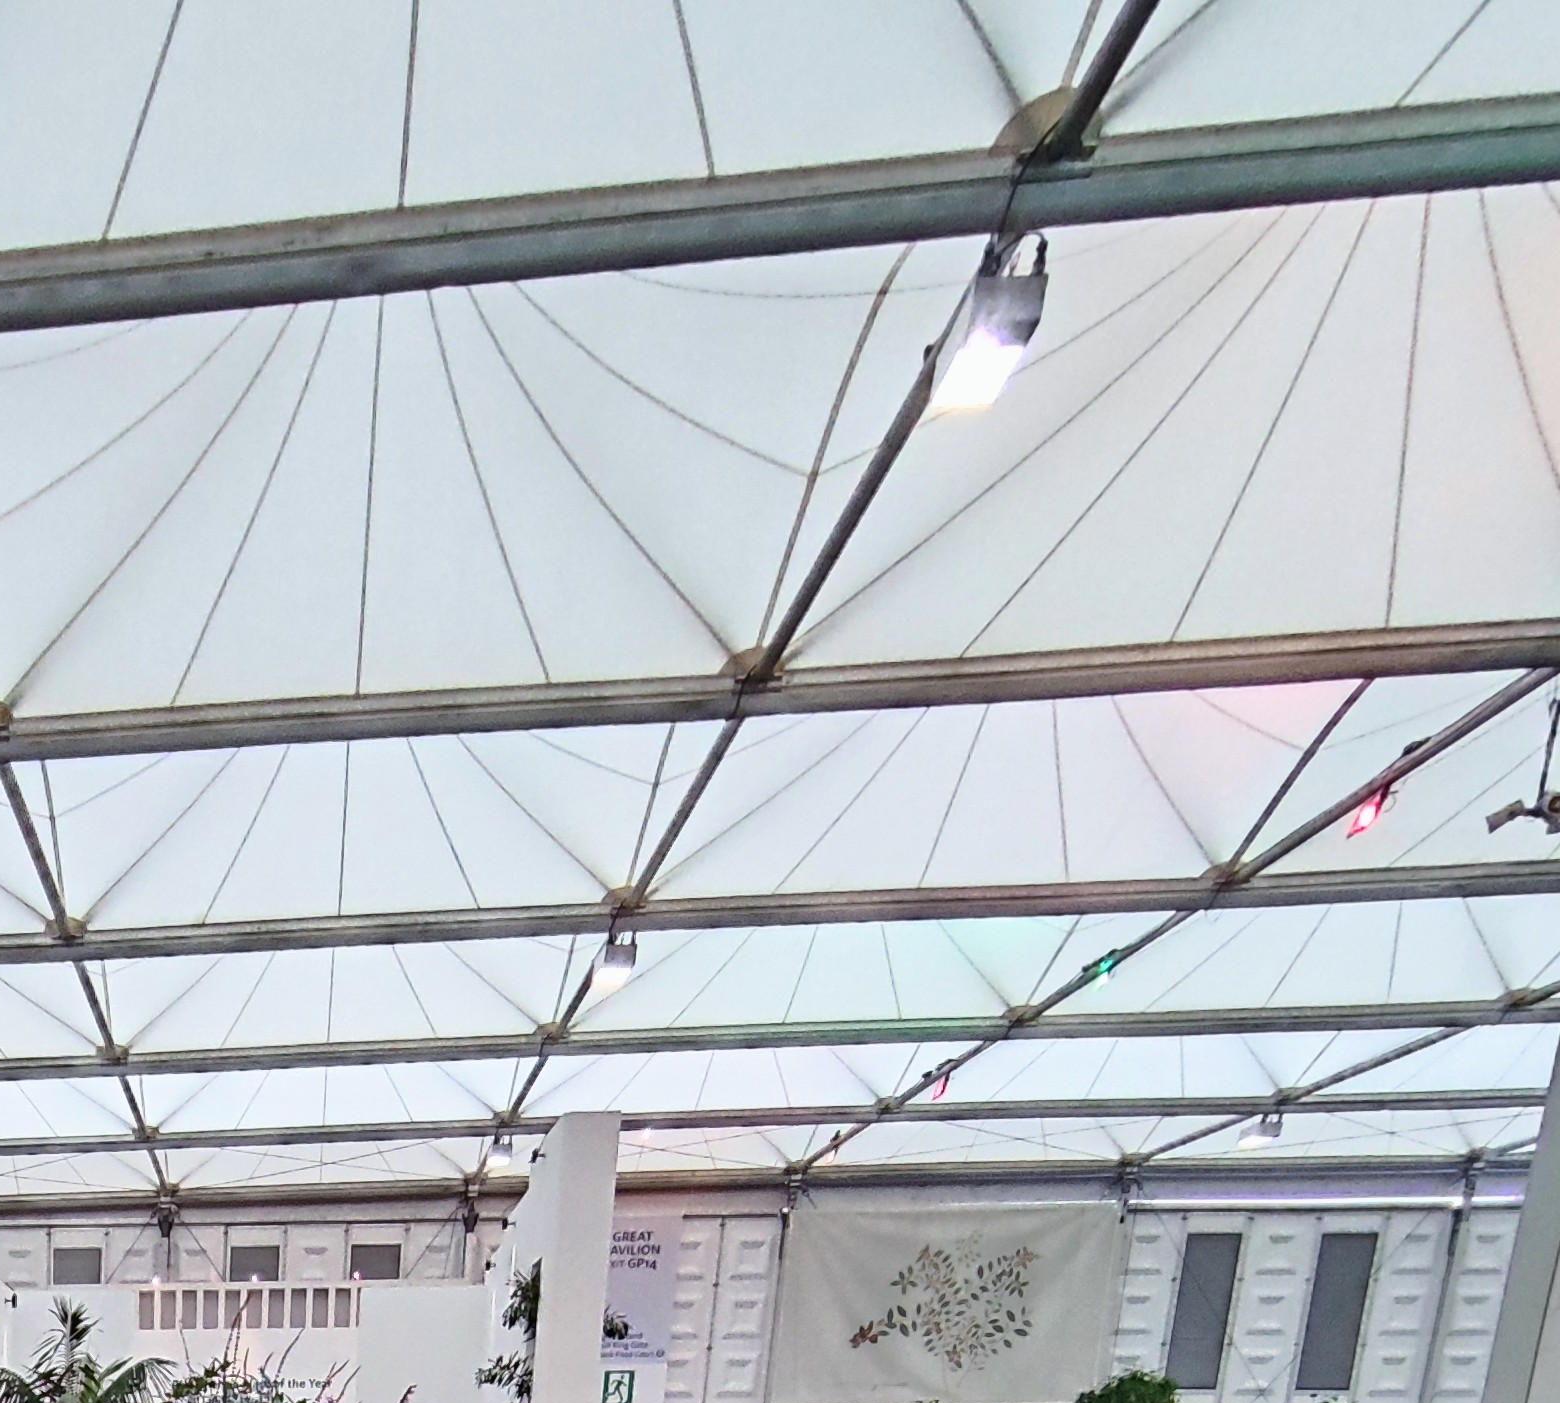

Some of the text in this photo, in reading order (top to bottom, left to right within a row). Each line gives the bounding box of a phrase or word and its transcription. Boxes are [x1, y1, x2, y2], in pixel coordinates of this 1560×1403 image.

[612, 1231, 654, 1242] GREAT
[609, 1244, 661, 1256] AVILION
[627, 1257, 657, 1270] GP14
[287, 1378, 307, 1389] the
[308, 1378, 333, 1390] Year
